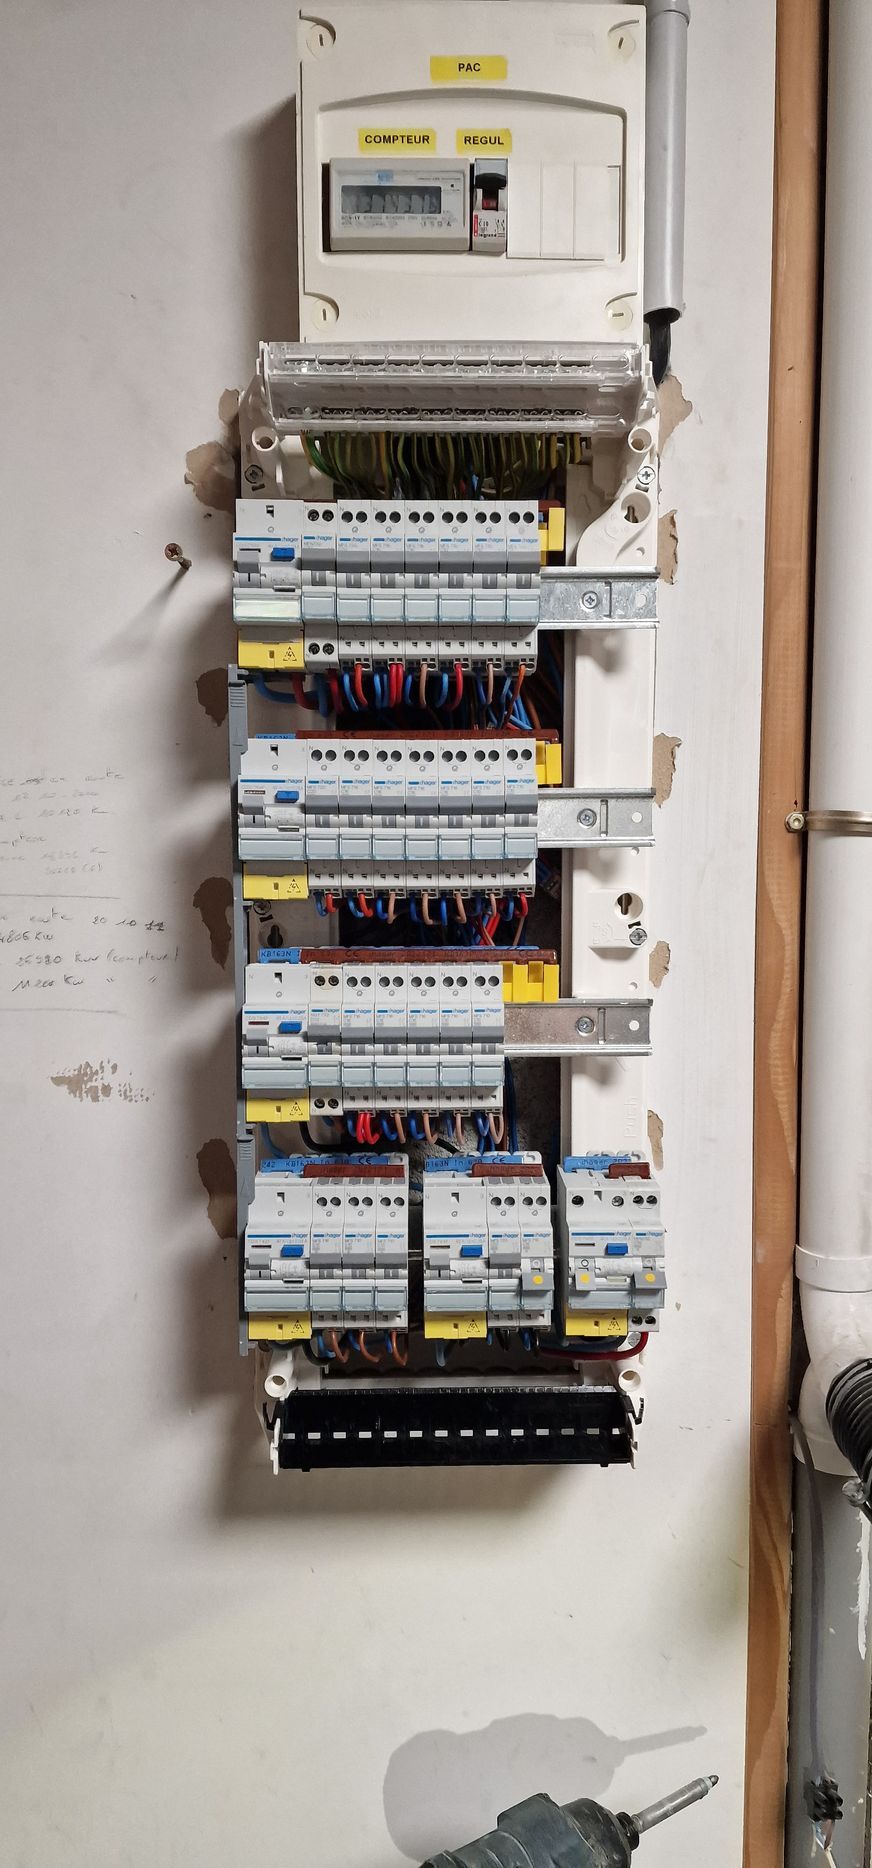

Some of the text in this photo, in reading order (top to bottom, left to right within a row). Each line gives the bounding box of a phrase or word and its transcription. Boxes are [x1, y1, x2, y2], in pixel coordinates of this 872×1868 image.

[458, 62, 481, 72] PAC
[364, 134, 430, 144] COMPTEUR
[463, 135, 504, 145] REGUL
[261, 950, 292, 958] KB163N
